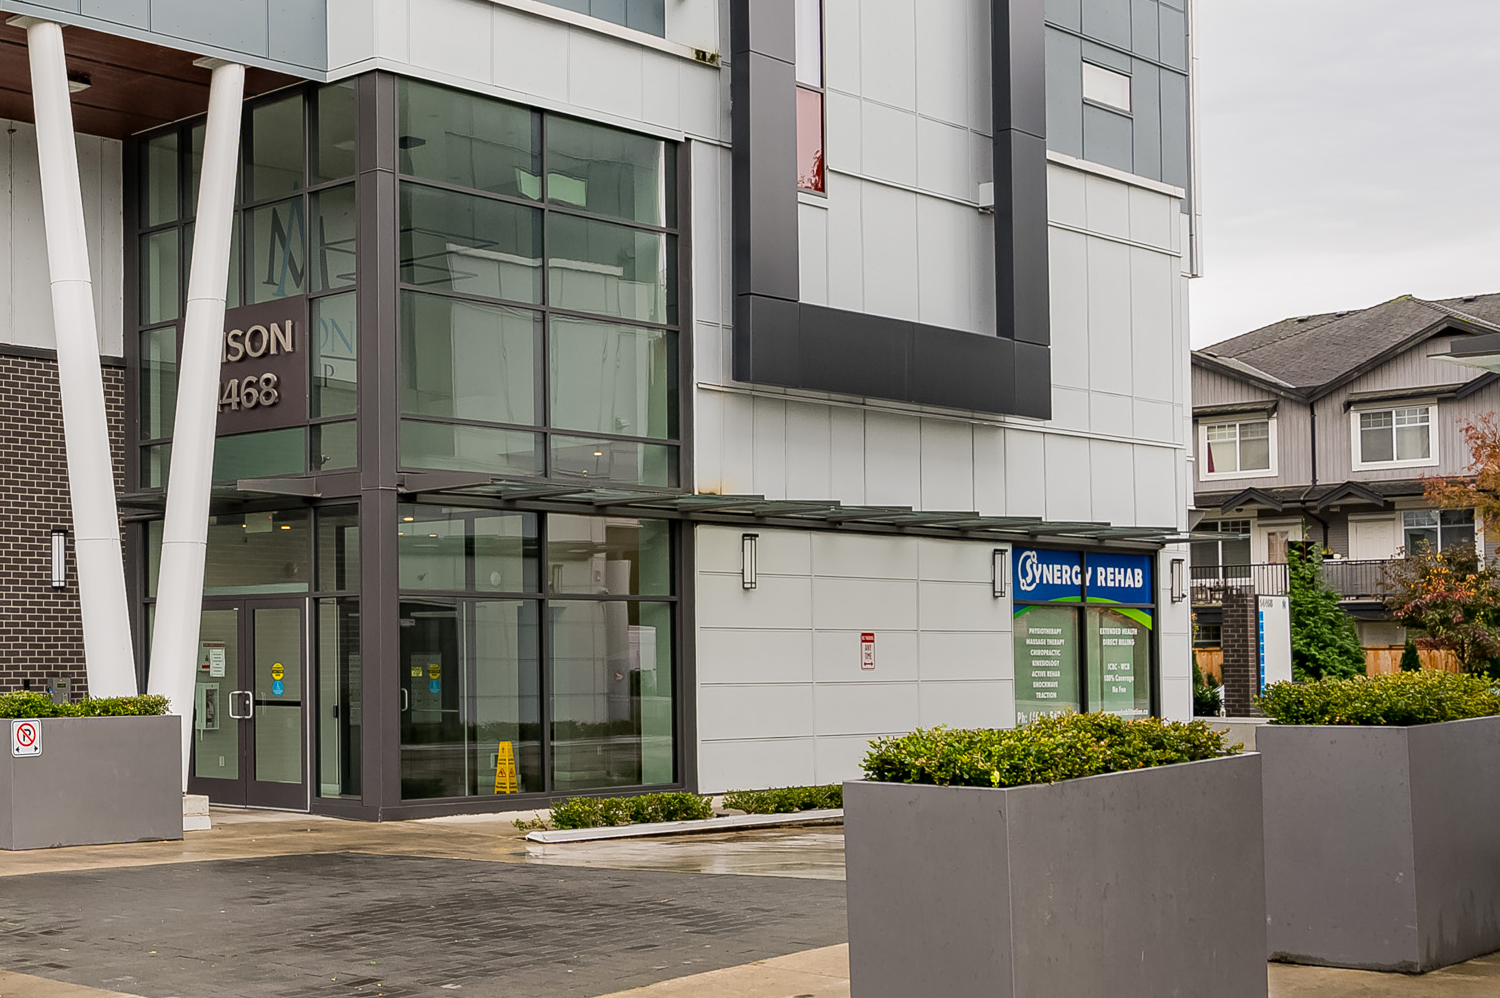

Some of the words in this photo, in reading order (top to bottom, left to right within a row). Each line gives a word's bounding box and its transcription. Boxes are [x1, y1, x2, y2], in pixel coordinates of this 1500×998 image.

[222, 320, 293, 363] SON
[1026, 558, 1092, 586] SYNERGY
[1097, 566, 1144, 588] REHAB
[1115, 674, 1134, 683] Coverage
